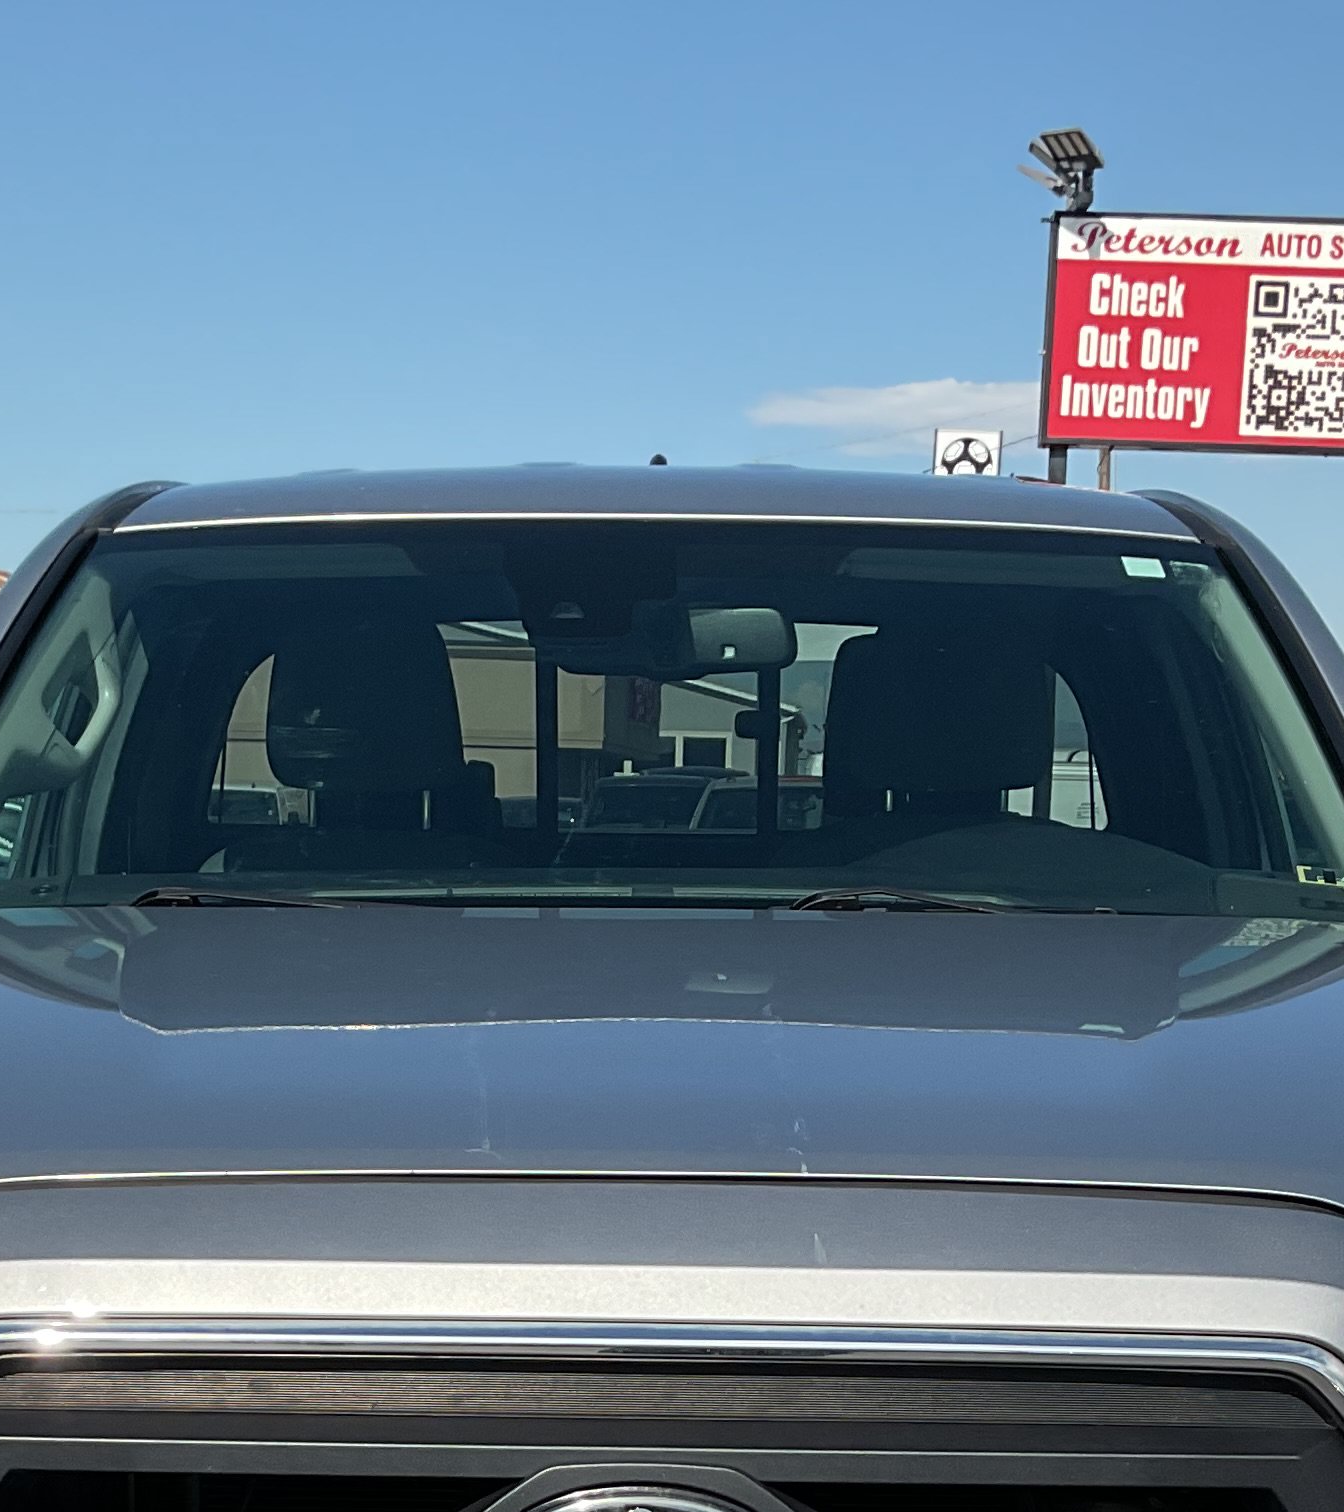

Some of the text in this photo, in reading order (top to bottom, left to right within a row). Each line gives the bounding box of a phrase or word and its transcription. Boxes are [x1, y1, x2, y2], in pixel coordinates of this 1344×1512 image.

[1070, 220, 1243, 259] Peterson
[1259, 232, 1321, 260] AUTO
[1090, 273, 1185, 318] Check
[1077, 325, 1200, 372] Out Our
[1060, 374, 1211, 429] Inventory
